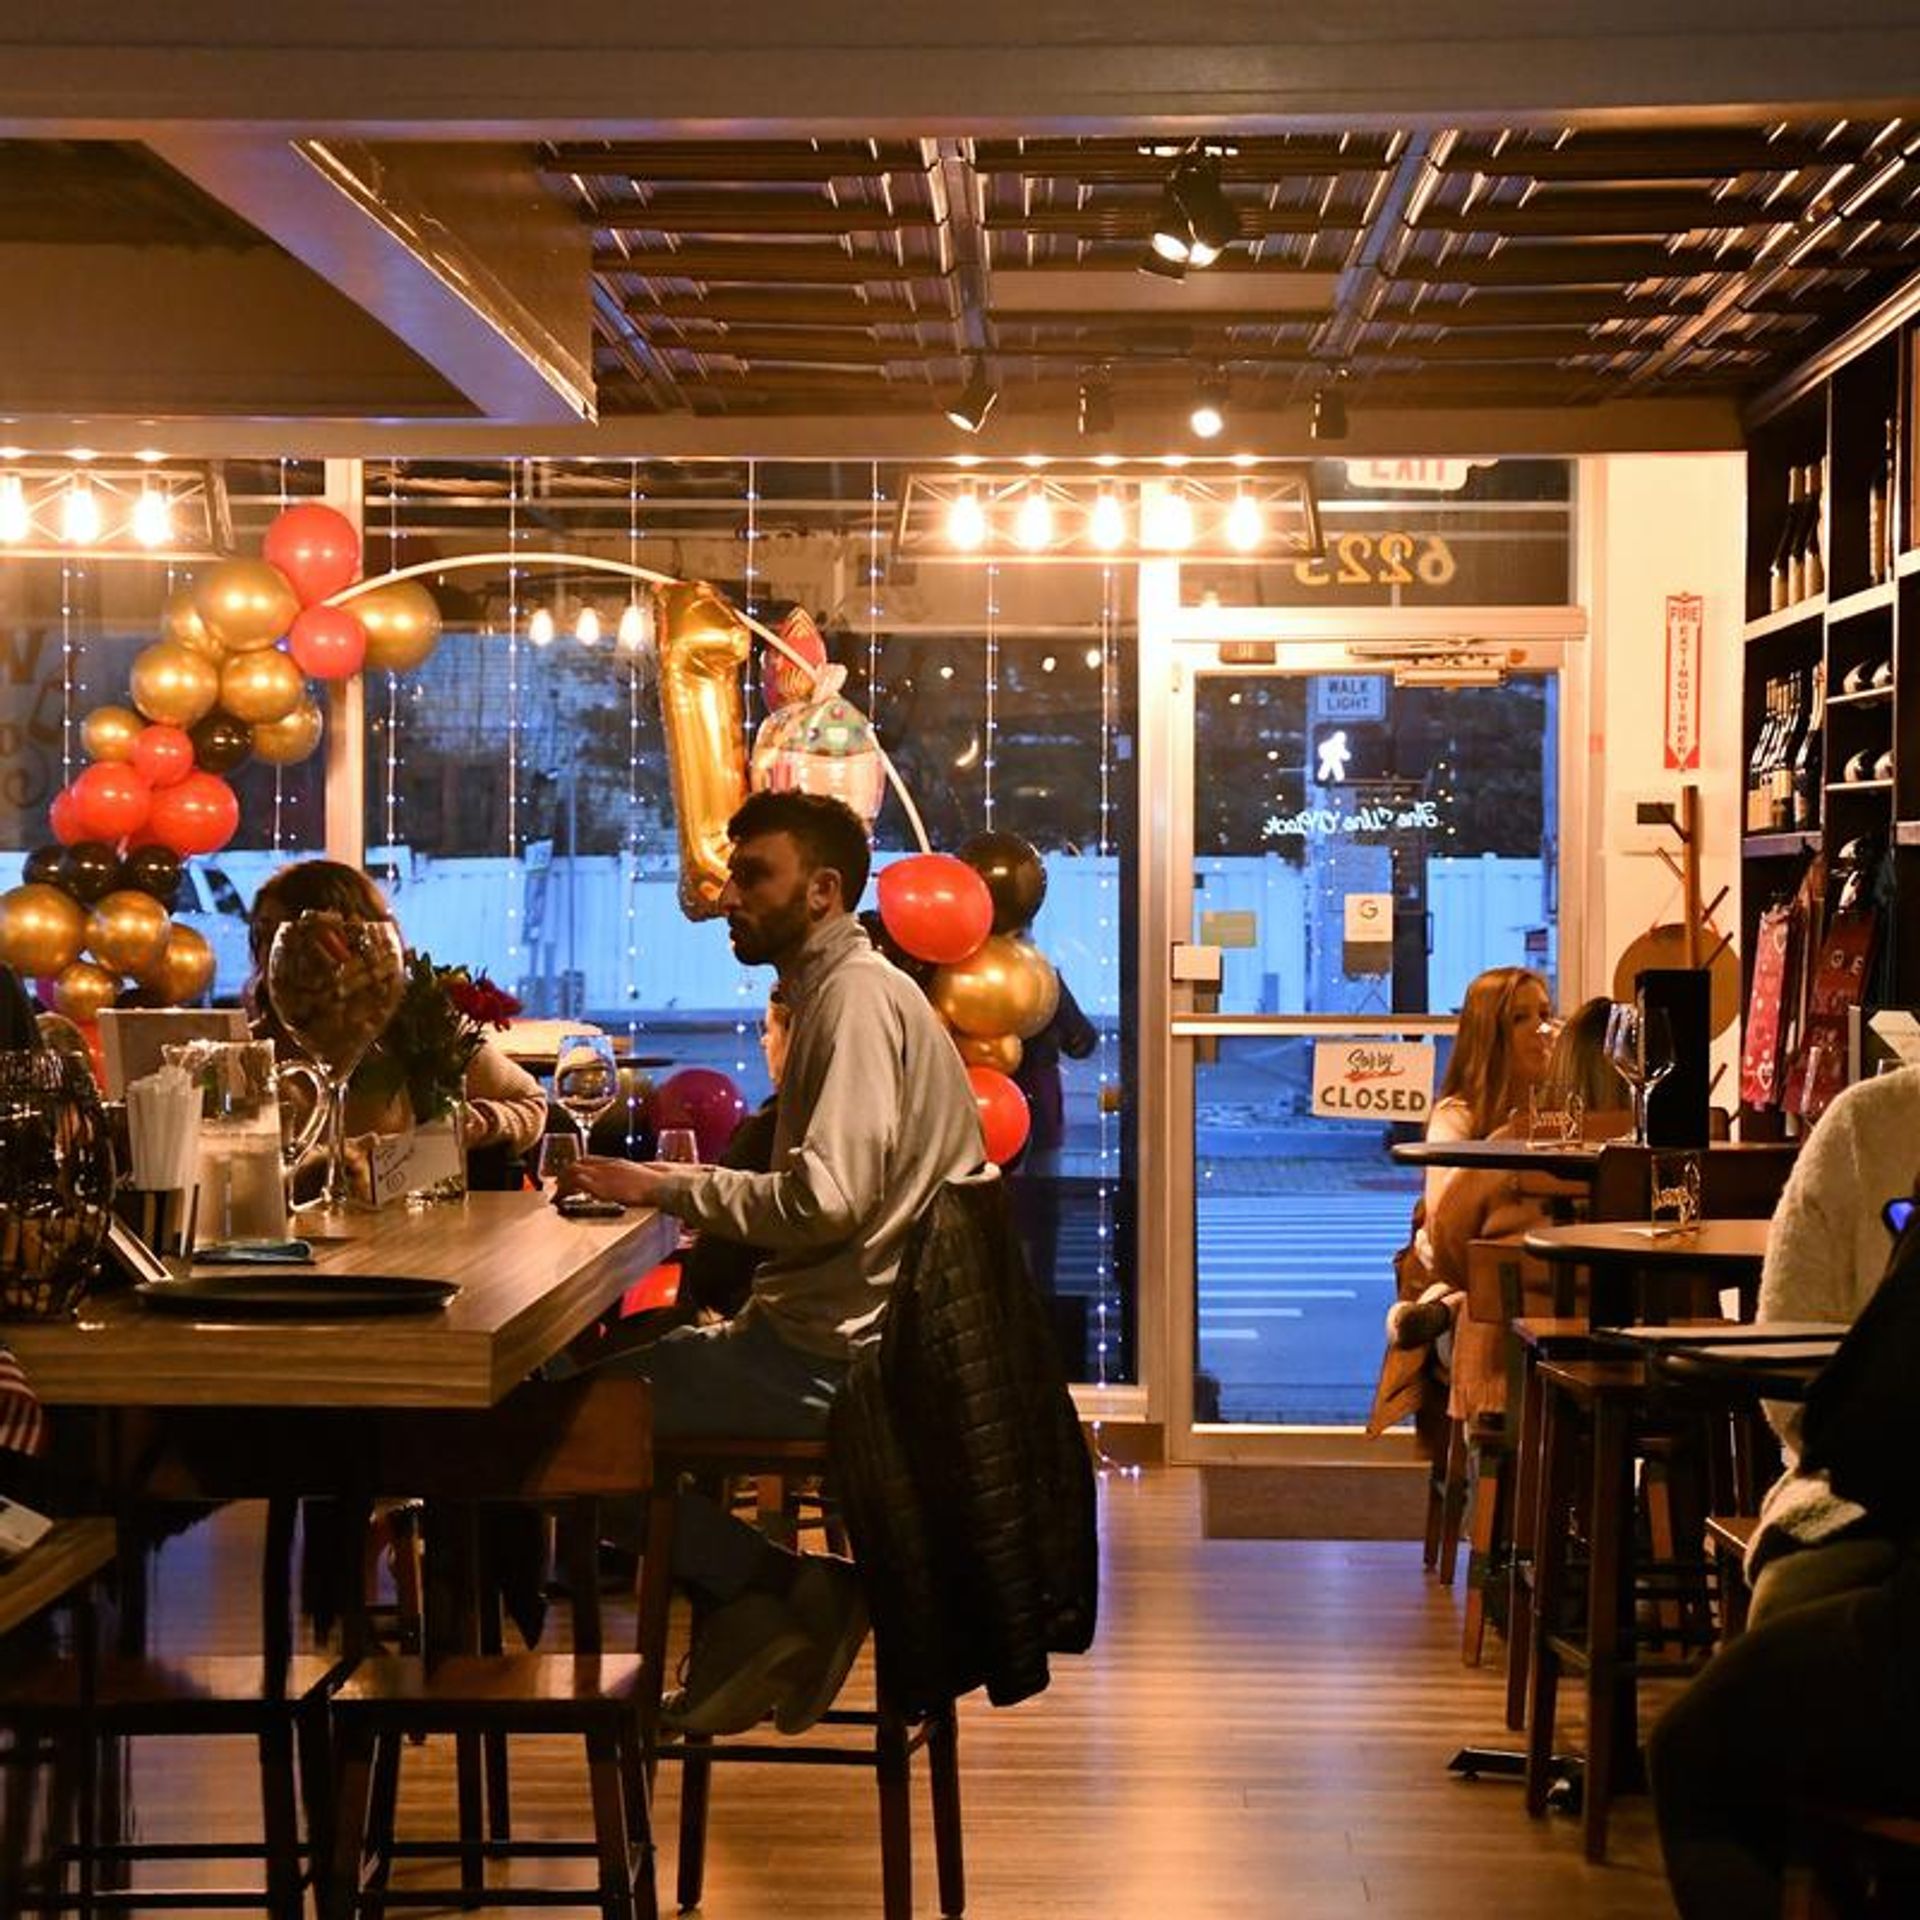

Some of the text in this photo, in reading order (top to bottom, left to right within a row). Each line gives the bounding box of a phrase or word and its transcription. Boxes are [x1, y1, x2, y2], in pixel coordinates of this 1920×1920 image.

[1670, 606, 1698, 622] FIRE
[1328, 679, 1369, 694] WALK
[1327, 697, 1369, 711] LIGHT
[1347, 1048, 1394, 1075] Sorry
[1321, 1086, 1426, 1111] CLOSED
